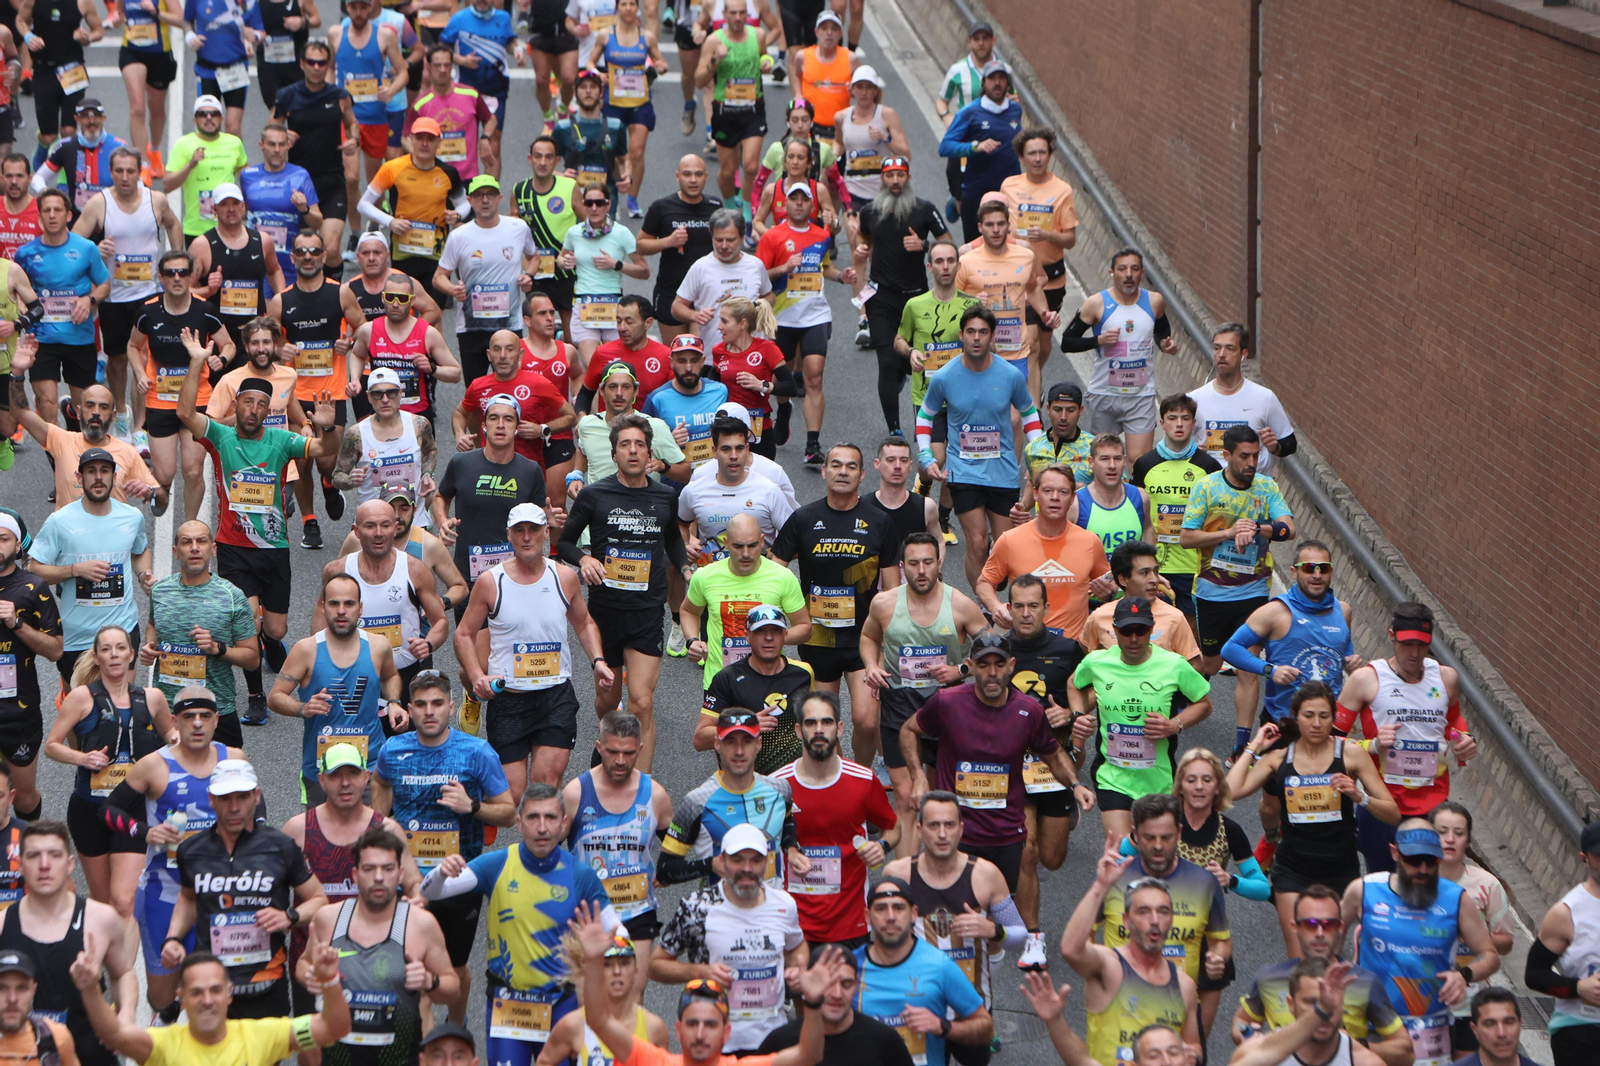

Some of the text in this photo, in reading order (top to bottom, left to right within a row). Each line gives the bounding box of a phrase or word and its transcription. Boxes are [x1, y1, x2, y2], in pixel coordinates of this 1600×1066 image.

[693, 413, 715, 426] MUR
[693, 444, 707, 452] 4906
[385, 457, 409, 465] ZURICH
[386, 469, 401, 477] 6412
[246, 475, 272, 483] ZURICH
[475, 475, 518, 491] FILA
[244, 487, 261, 495] 5016
[239, 497, 265, 505] CAMACHO
[606, 517, 639, 526] ZUBIRI
[708, 514, 731, 523] olim
[618, 524, 661, 533] PAMPLONA
[484, 545, 510, 555] ZURICH
[812, 543, 867, 555] ARUNCI
[621, 551, 647, 559] ZURICH
[619, 564, 636, 572] 4920
[618, 574, 636, 582] MANDI
[92, 581, 109, 589] 3448
[823, 601, 839, 610] 5498
[368, 617, 396, 626] ZURICH
[173, 645, 201, 654] ZURICH
[530, 643, 556, 652] ZURICH
[915, 647, 942, 655] ZURICH
[1105, 704, 1163, 712] MARBELLA
[1387, 709, 1407, 717] CLUB
[1396, 716, 1437, 725] ALGECIRAS
[335, 726, 364, 734] ZURICH
[1123, 726, 1145, 735] ZURIC
[1122, 740, 1139, 748] 7064
[1406, 743, 1434, 751] ZURICH
[974, 764, 1004, 772] ZURICH
[973, 779, 991, 787] 5152
[1303, 792, 1322, 801] 6151
[422, 822, 454, 831] ZURICH
[422, 836, 441, 845] 4714
[418, 849, 446, 857] ROBERTO
[805, 848, 835, 857] ZURICH
[611, 865, 641, 877] ZURICH
[195, 870, 275, 895] Heróis
[612, 882, 631, 891] 4864
[233, 896, 272, 906] BETANO
[609, 895, 633, 904] NTONIO
[722, 954, 748, 963] MEDIA
[742, 969, 773, 979] ZURICH
[356, 992, 389, 1003] ZURICH
[741, 1000, 763, 1008] PEDRO
[516, 1021, 541, 1029] CARLOS
